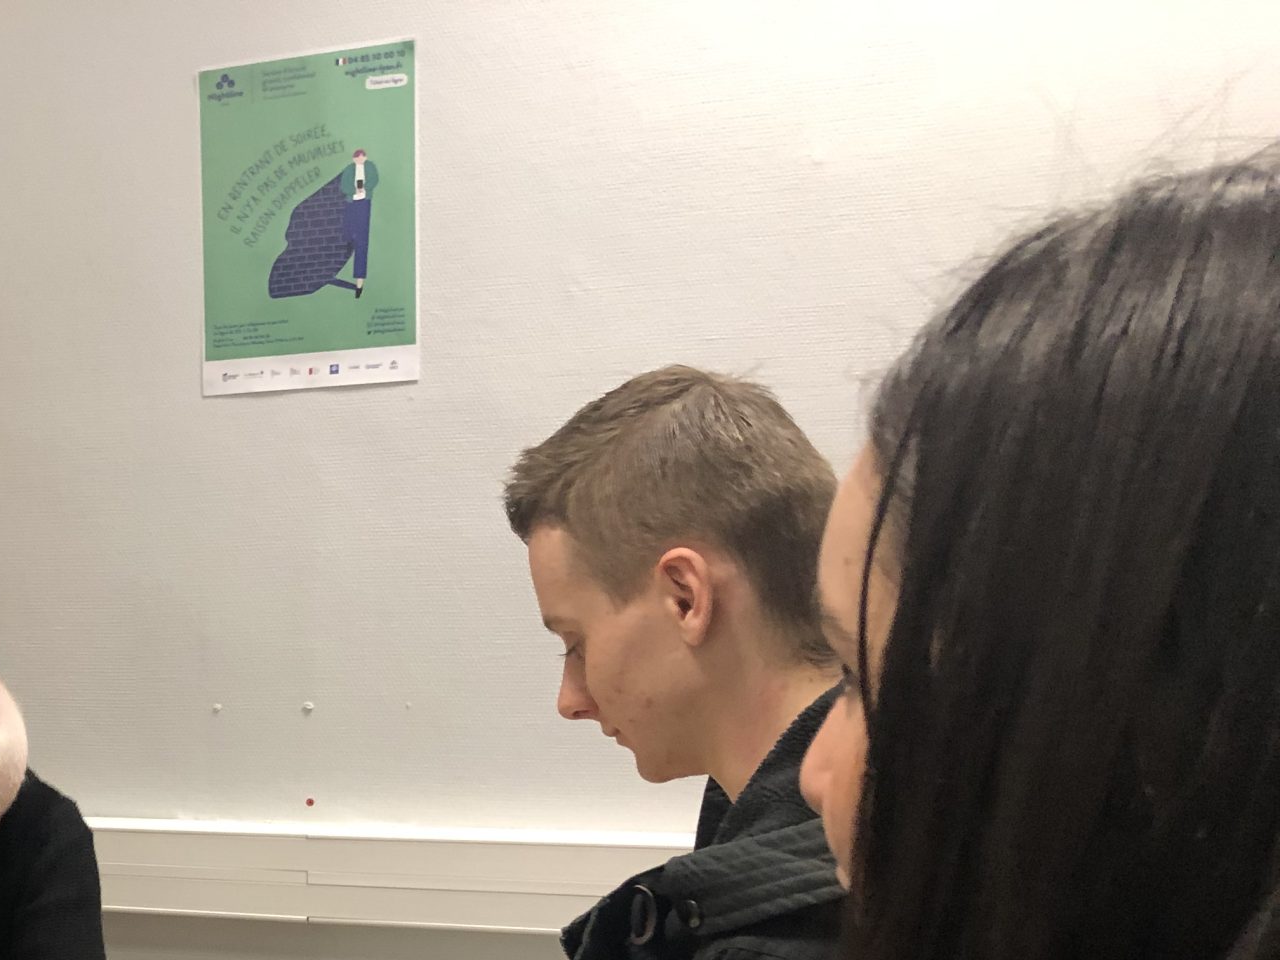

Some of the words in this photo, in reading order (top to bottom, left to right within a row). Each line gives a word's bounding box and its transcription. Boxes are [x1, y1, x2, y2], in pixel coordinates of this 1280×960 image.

[217, 202, 235, 221] EN
[228, 149, 277, 201] RENTRANT
[273, 139, 289, 157] DE
[257, 176, 277, 196] PAS
[273, 164, 288, 181] DE
[242, 207, 277, 248] RAISON
